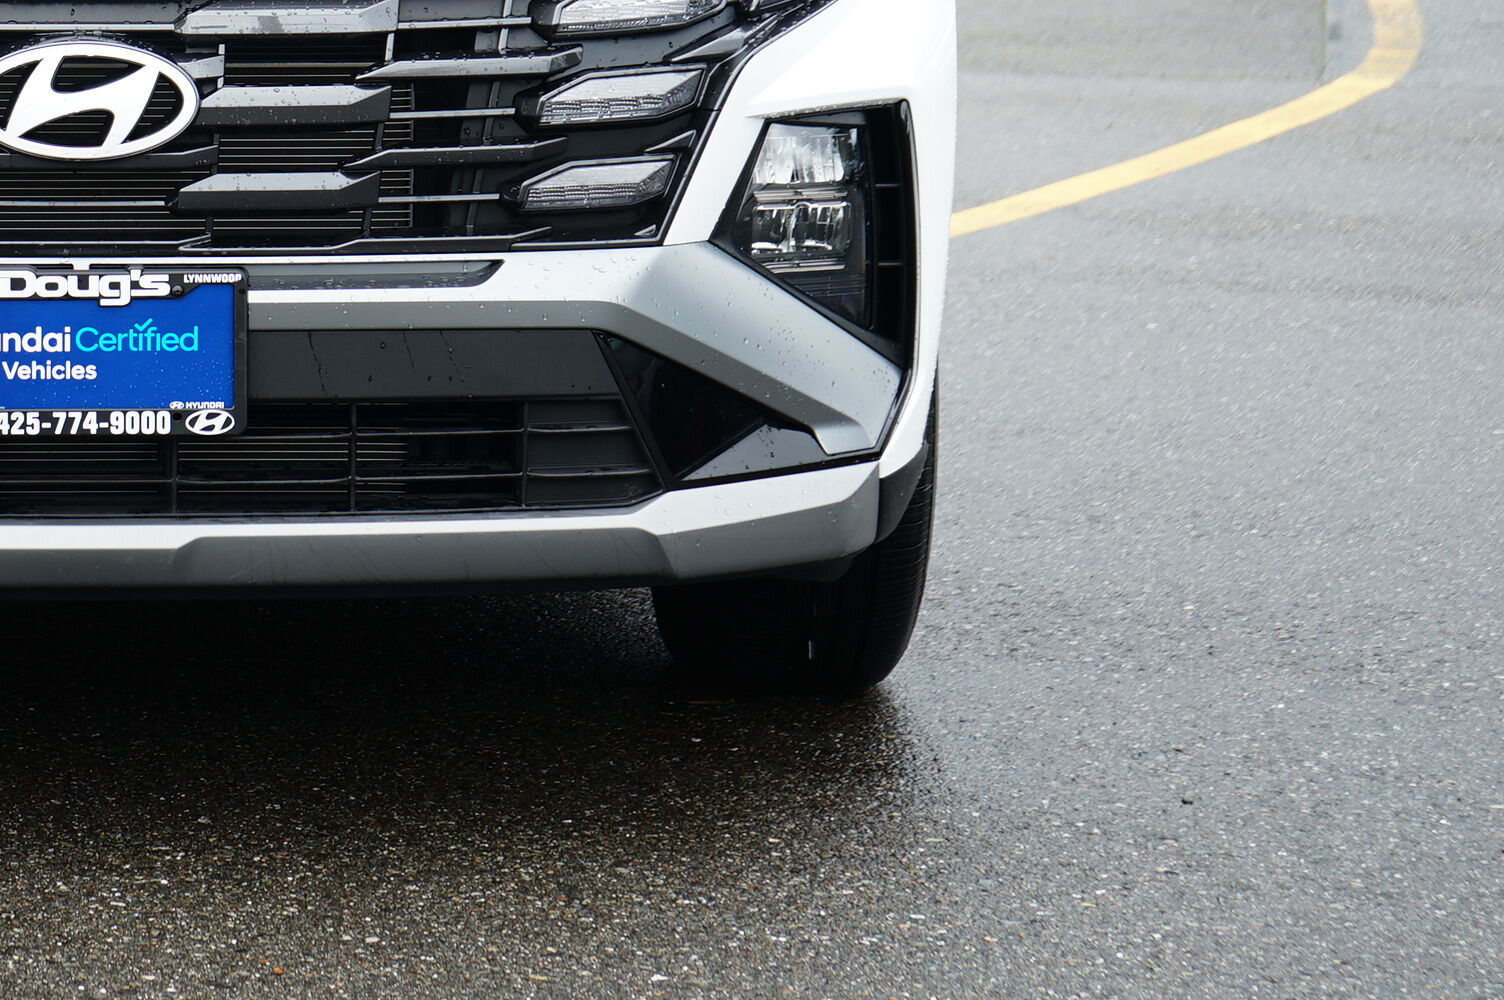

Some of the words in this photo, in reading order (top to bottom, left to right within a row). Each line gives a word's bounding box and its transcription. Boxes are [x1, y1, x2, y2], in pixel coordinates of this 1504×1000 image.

[184, 273, 242, 283] LYNNWOOD
[76, 318, 198, 352] Certified
[2, 361, 97, 380] Vehicles
[186, 401, 224, 409] HYUNDAI
